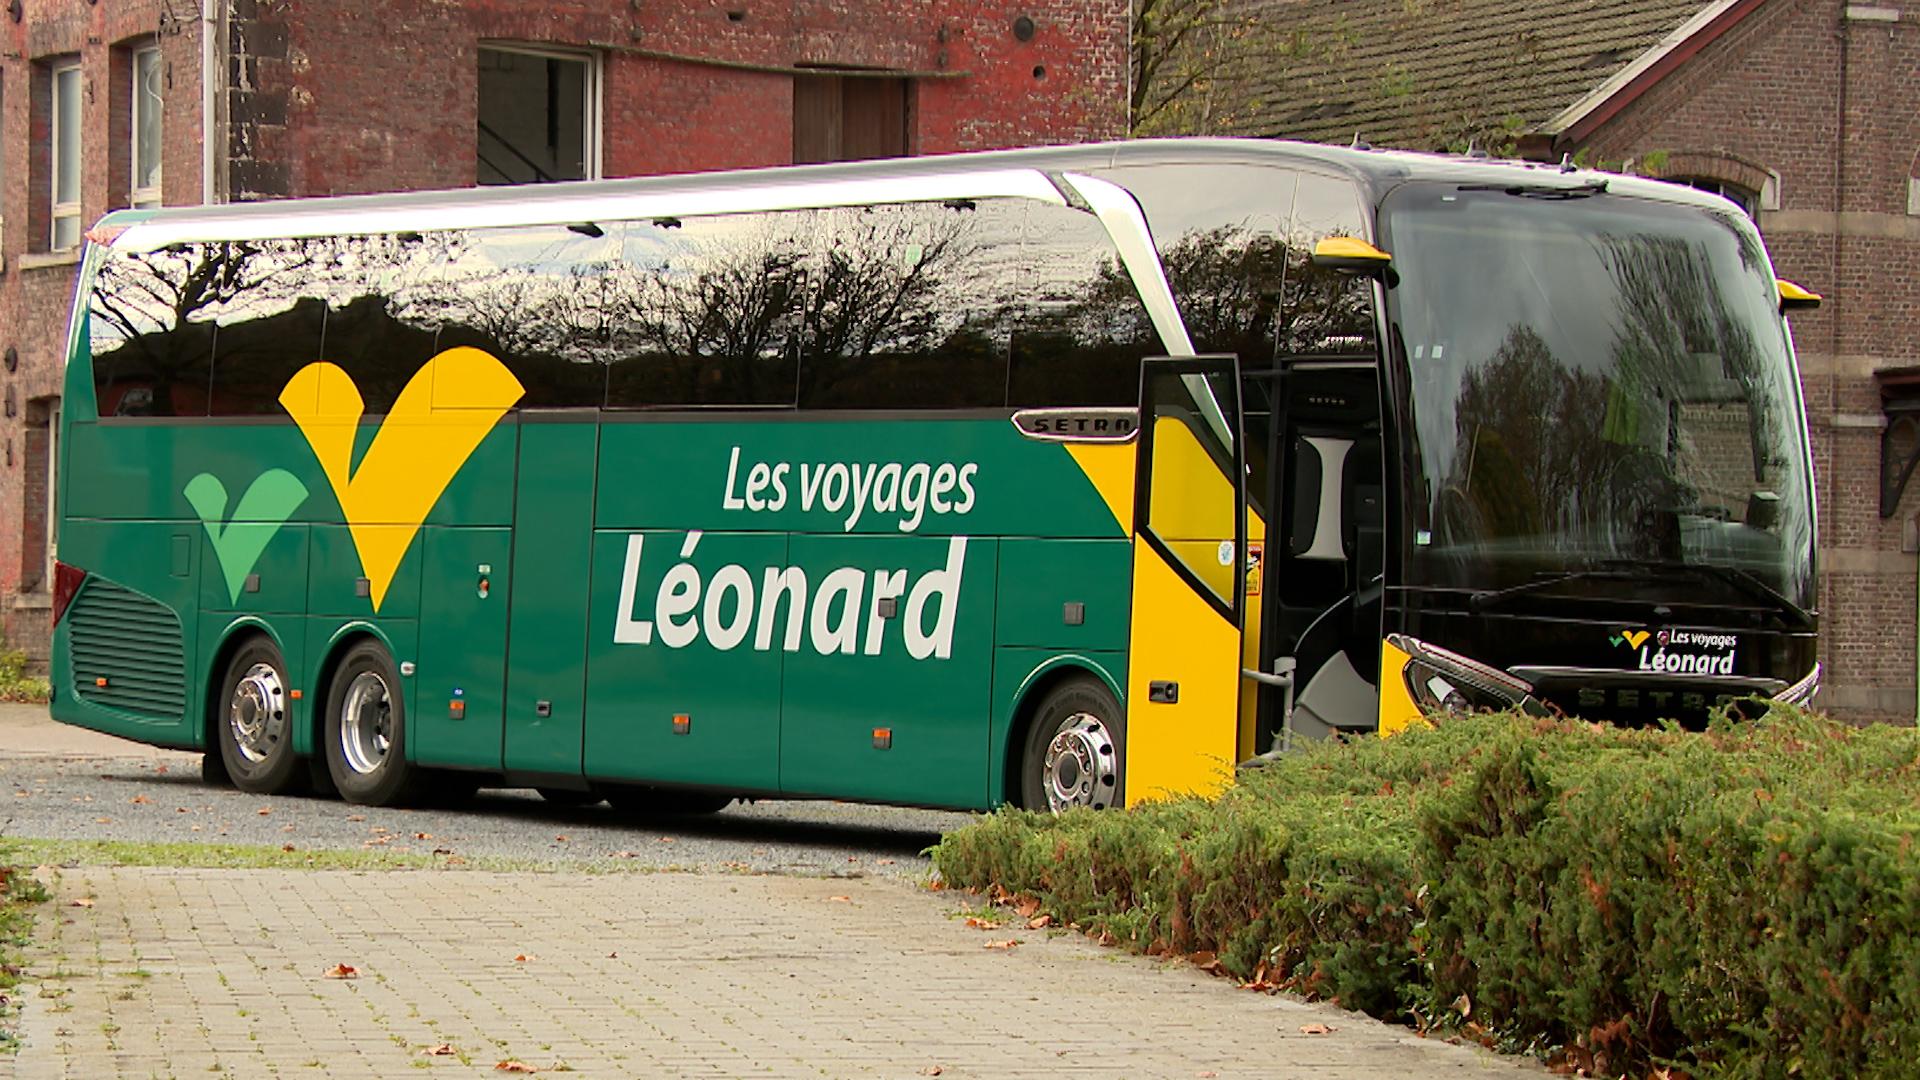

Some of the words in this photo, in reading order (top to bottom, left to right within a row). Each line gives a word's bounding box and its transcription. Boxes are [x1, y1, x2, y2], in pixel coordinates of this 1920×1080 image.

[1033, 418, 1131, 432] SETRA
[723, 447, 790, 511] Les
[800, 462, 978, 533] voyages
[613, 530, 968, 660] Léonard
[1670, 628, 1689, 643] Les
[1690, 632, 1736, 650] voyages
[1639, 645, 1735, 674] Léonard
